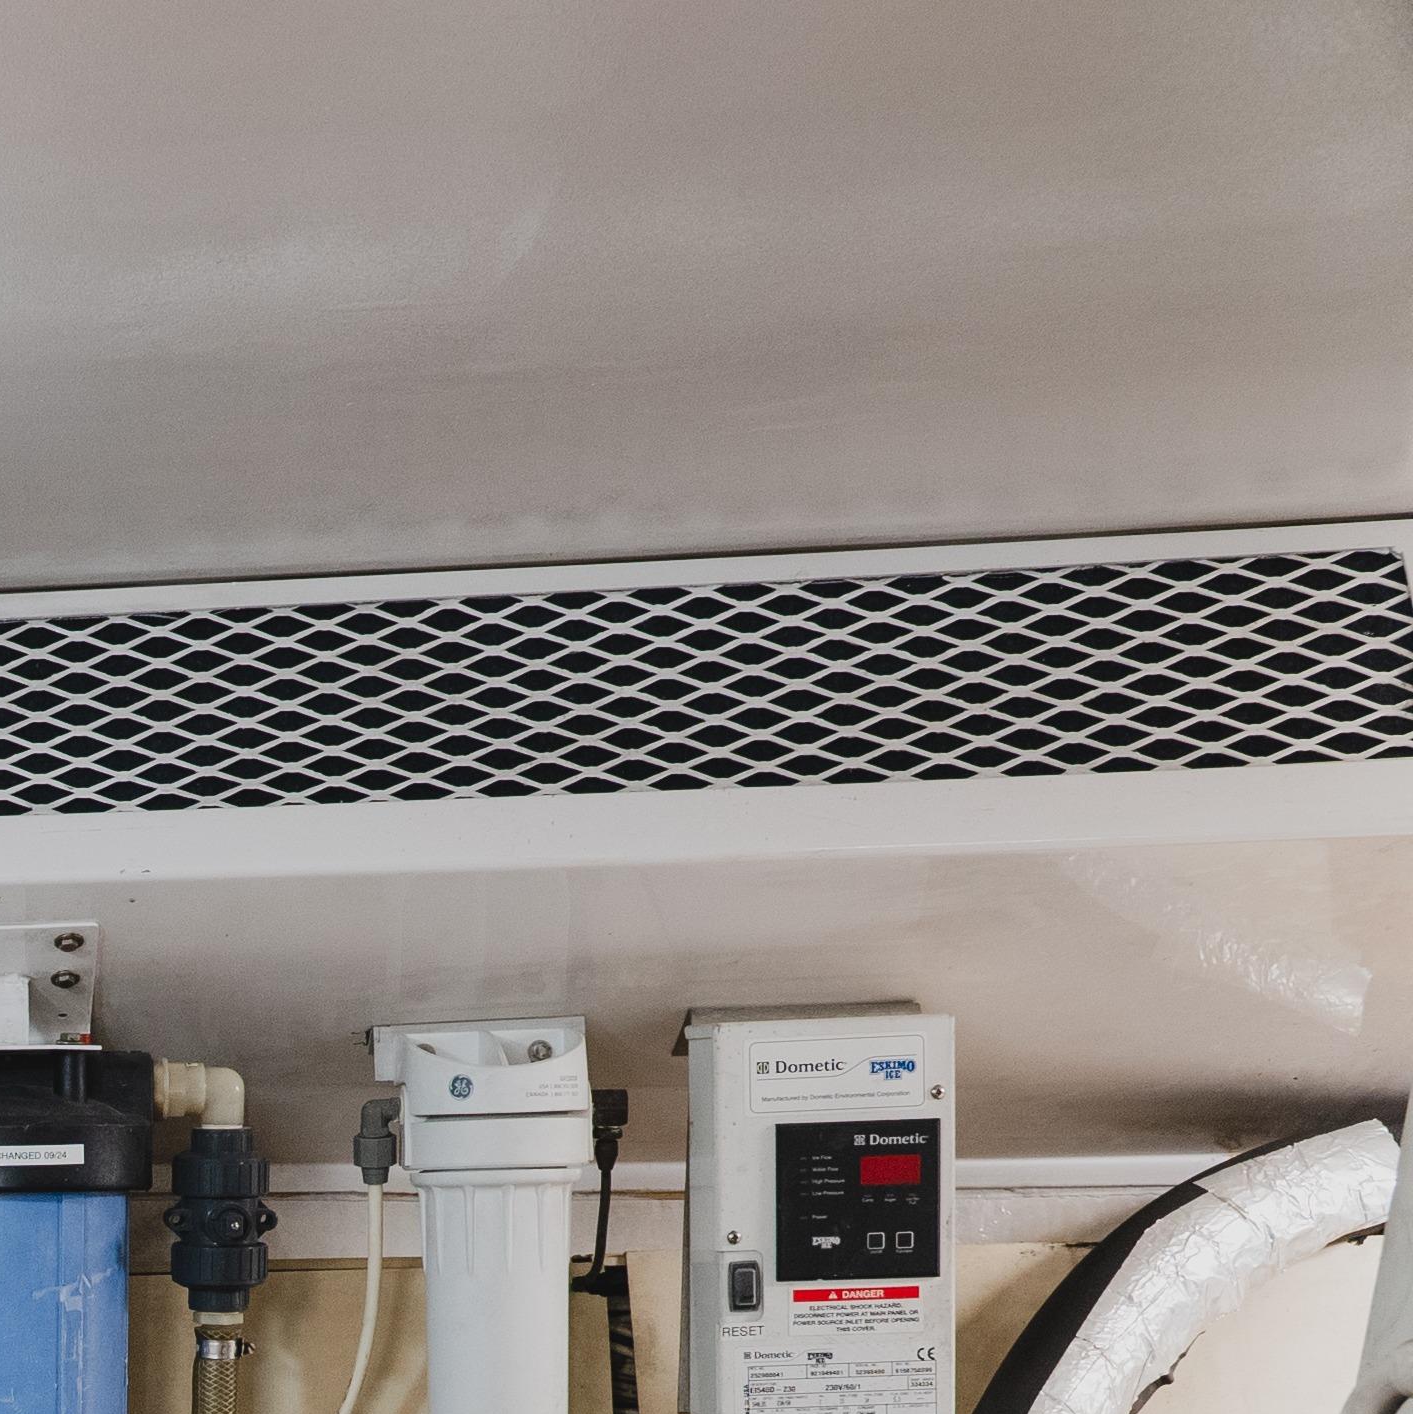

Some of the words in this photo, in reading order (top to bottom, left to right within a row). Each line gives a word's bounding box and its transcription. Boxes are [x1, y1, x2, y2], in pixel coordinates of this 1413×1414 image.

[776, 1059, 845, 1074] Dometic
[871, 1060, 915, 1073] ESKIMO
[885, 1071, 901, 1080] ICE
[870, 1133, 926, 1145] Dometic
[44, 1151, 67, 1160] 09/24
[842, 1290, 884, 1299] DANGER
[722, 1325, 765, 1337] RESET
[754, 1351, 793, 1360] Dometic
[917, 1347, 936, 1361] CE
